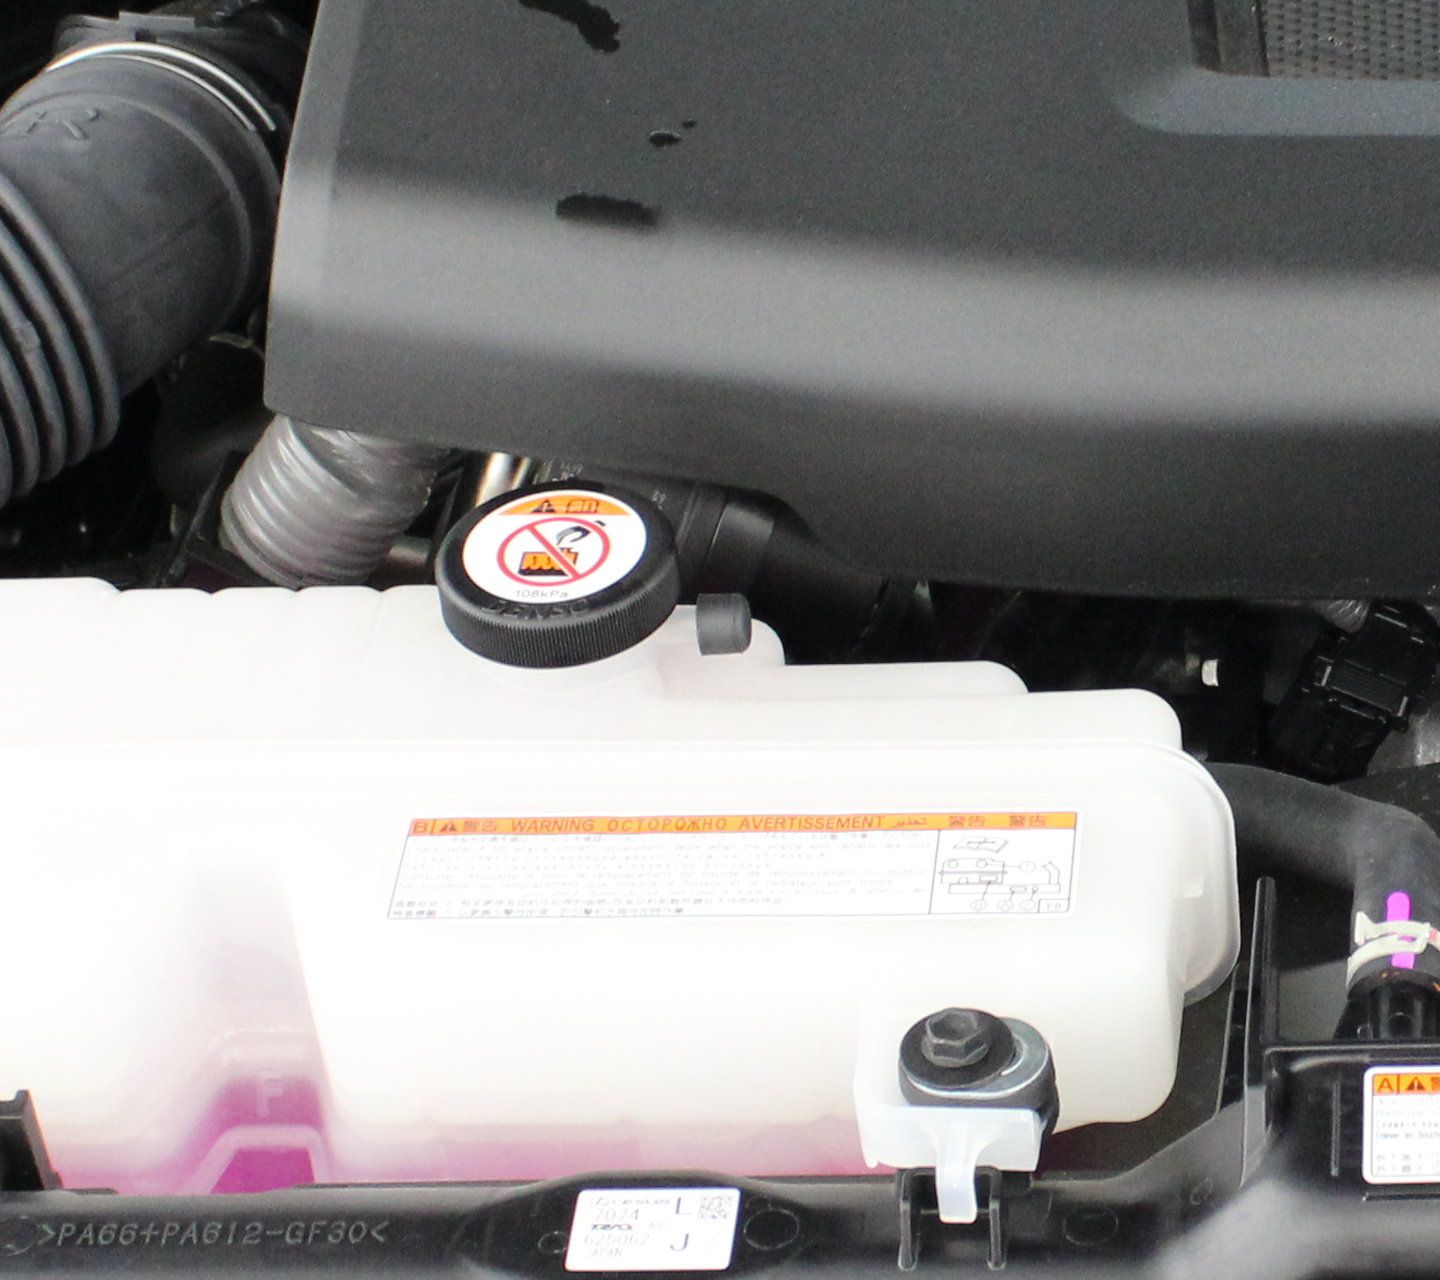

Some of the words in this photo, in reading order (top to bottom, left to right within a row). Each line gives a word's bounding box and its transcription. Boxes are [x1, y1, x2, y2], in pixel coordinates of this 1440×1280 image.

[514, 589, 569, 600] 108kPa
[511, 819, 596, 833] WARNING
[738, 815, 886, 830] AVERTISSEMENT
[1377, 1076, 1394, 1092] A
